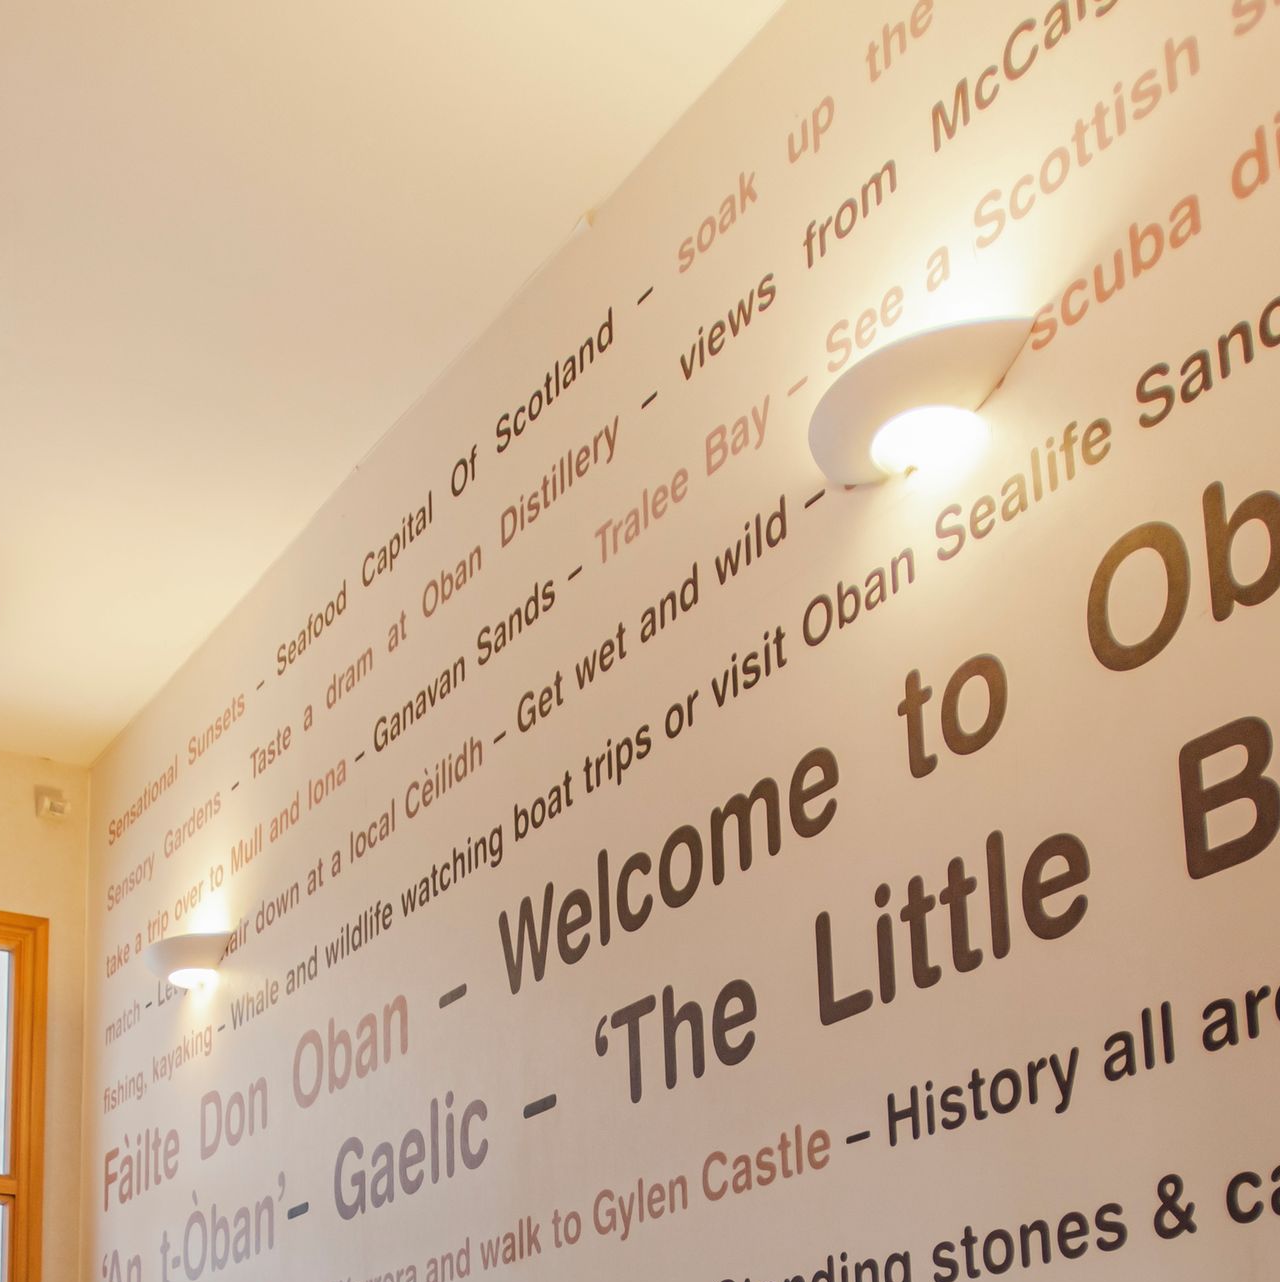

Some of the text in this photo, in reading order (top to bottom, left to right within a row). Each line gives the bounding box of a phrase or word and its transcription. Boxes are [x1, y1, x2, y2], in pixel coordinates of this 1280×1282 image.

[104, 1072, 147, 1113] fishing,
[153, 1024, 212, 1083] kayaking
[231, 973, 279, 1031] Whale
[286, 945, 318, 995] and
[325, 900, 392, 968] wildlife
[401, 824, 503, 917] watching
[514, 770, 573, 842] boat
[583, 725, 651, 793] trips
[665, 690, 699, 739] or
[712, 626, 787, 707] visit
[803, 548, 914, 647] Oban
[935, 418, 1112, 561] Sealife
[106, 36, 1201, 979] take a trip over to Mull and Iona Ganavan Sands Tralee Bay See a Scottish
[106, 1000, 140, 1046] match
[256, 882, 299, 934] down
[307, 858, 323, 896] at
[332, 850, 341, 877] a
[350, 798, 395, 864] local
[405, 736, 482, 819] Cèilidh
[517, 671, 563, 732] Get
[576, 622, 627, 690] wet
[641, 562, 698, 643] and
[715, 494, 787, 585] wild
[1031, 193, 1202, 352] scuba
[107, 0, 934, 846] Sensational Sunsets Seafood Capital Of Scotland soak up the
[107, 0, 1118, 911] Sensory Gardens Taste a dram at Oban Distillery views from McCa
[104, 1127, 179, 1212] Fàilte
[200, 1077, 267, 1160] Don
[293, 995, 408, 1109] Oban
[499, 748, 839, 995] Welcome
[898, 654, 1007, 778] to
[334, 1091, 488, 1220] Gaelic
[815, 830, 1090, 1026] Little
[480, 1216, 541, 1270] walk
[552, 1209, 581, 1248] to
[593, 1175, 688, 1241] Gylen
[702, 1124, 831, 1201] Castle
[887, 1047, 1079, 1147] History
[1104, 1001, 1175, 1081] all
[1154, 1174, 1197, 1239] &
